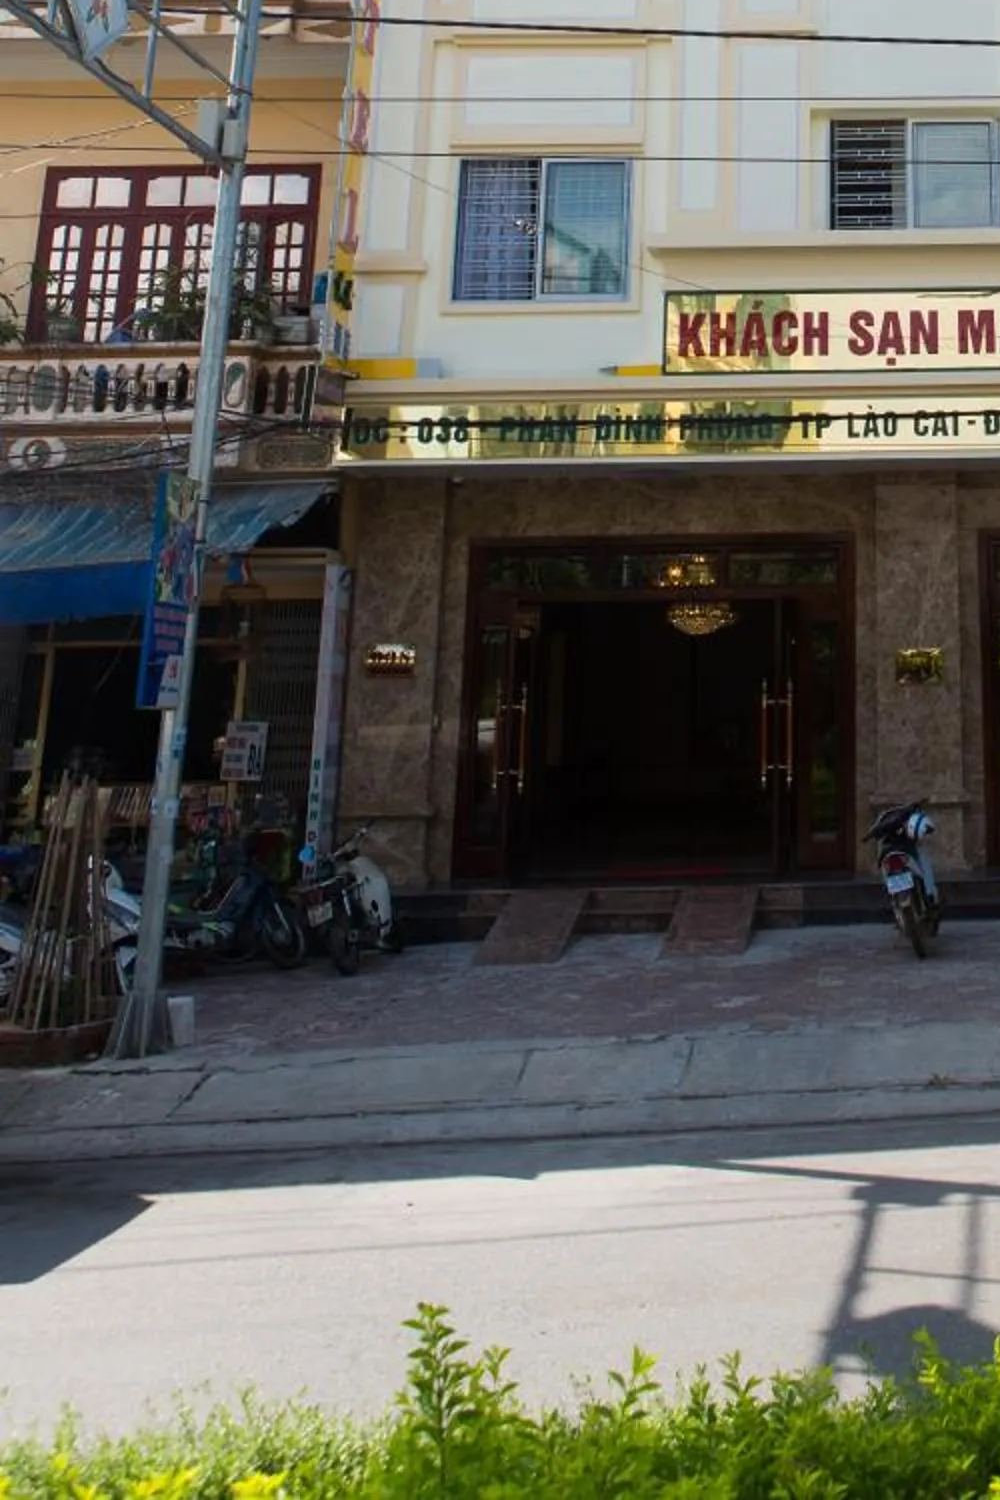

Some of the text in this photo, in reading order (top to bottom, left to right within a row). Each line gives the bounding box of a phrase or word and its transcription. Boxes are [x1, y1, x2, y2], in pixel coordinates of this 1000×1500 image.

[677, 300, 829, 357] KHÁCH
[848, 309, 938, 366] SẠN
[417, 415, 470, 444] 038
[799, 411, 832, 438] TP
[847, 404, 898, 438] LÀO
